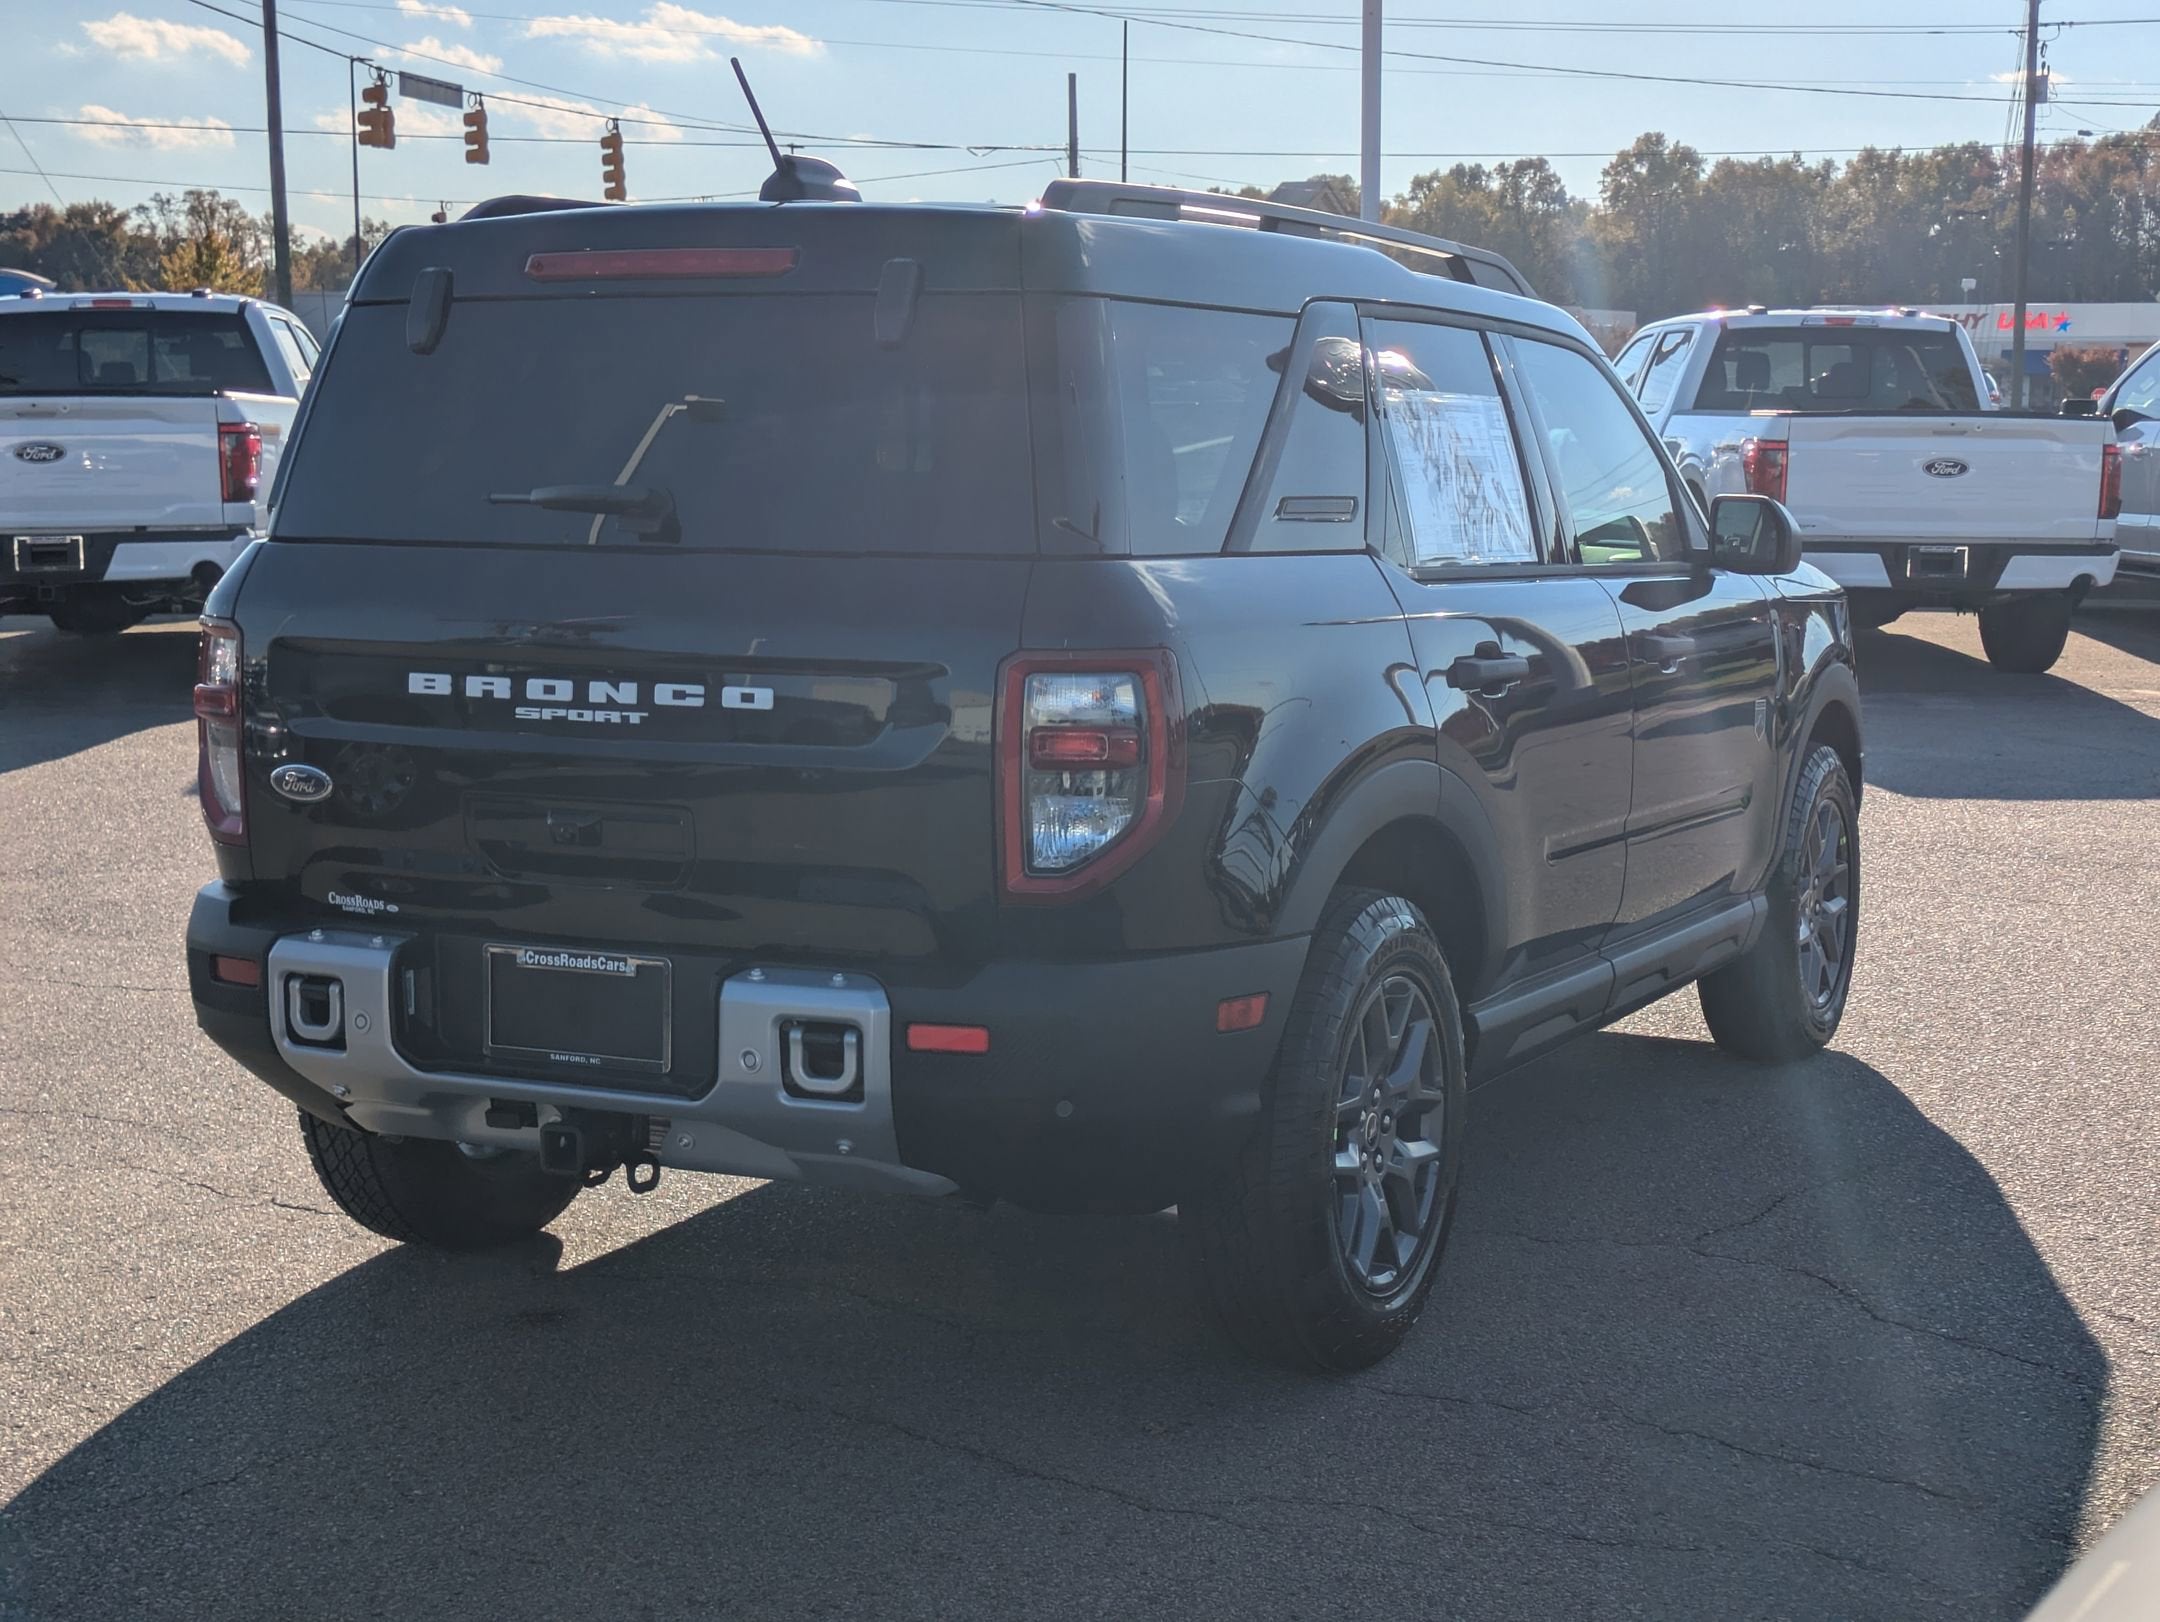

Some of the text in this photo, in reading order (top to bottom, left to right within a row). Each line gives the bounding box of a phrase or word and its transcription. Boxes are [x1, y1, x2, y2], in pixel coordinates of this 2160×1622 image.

[22, 446, 57, 460] Ford
[1931, 461, 1961, 475] Ford
[408, 672, 774, 710] BRONCO
[515, 706, 649, 724] SPORT
[282, 771, 316, 793] Ford
[526, 951, 626, 972] CrossRoadsCars
[550, 1053, 601, 1065] SANFORD, NC
